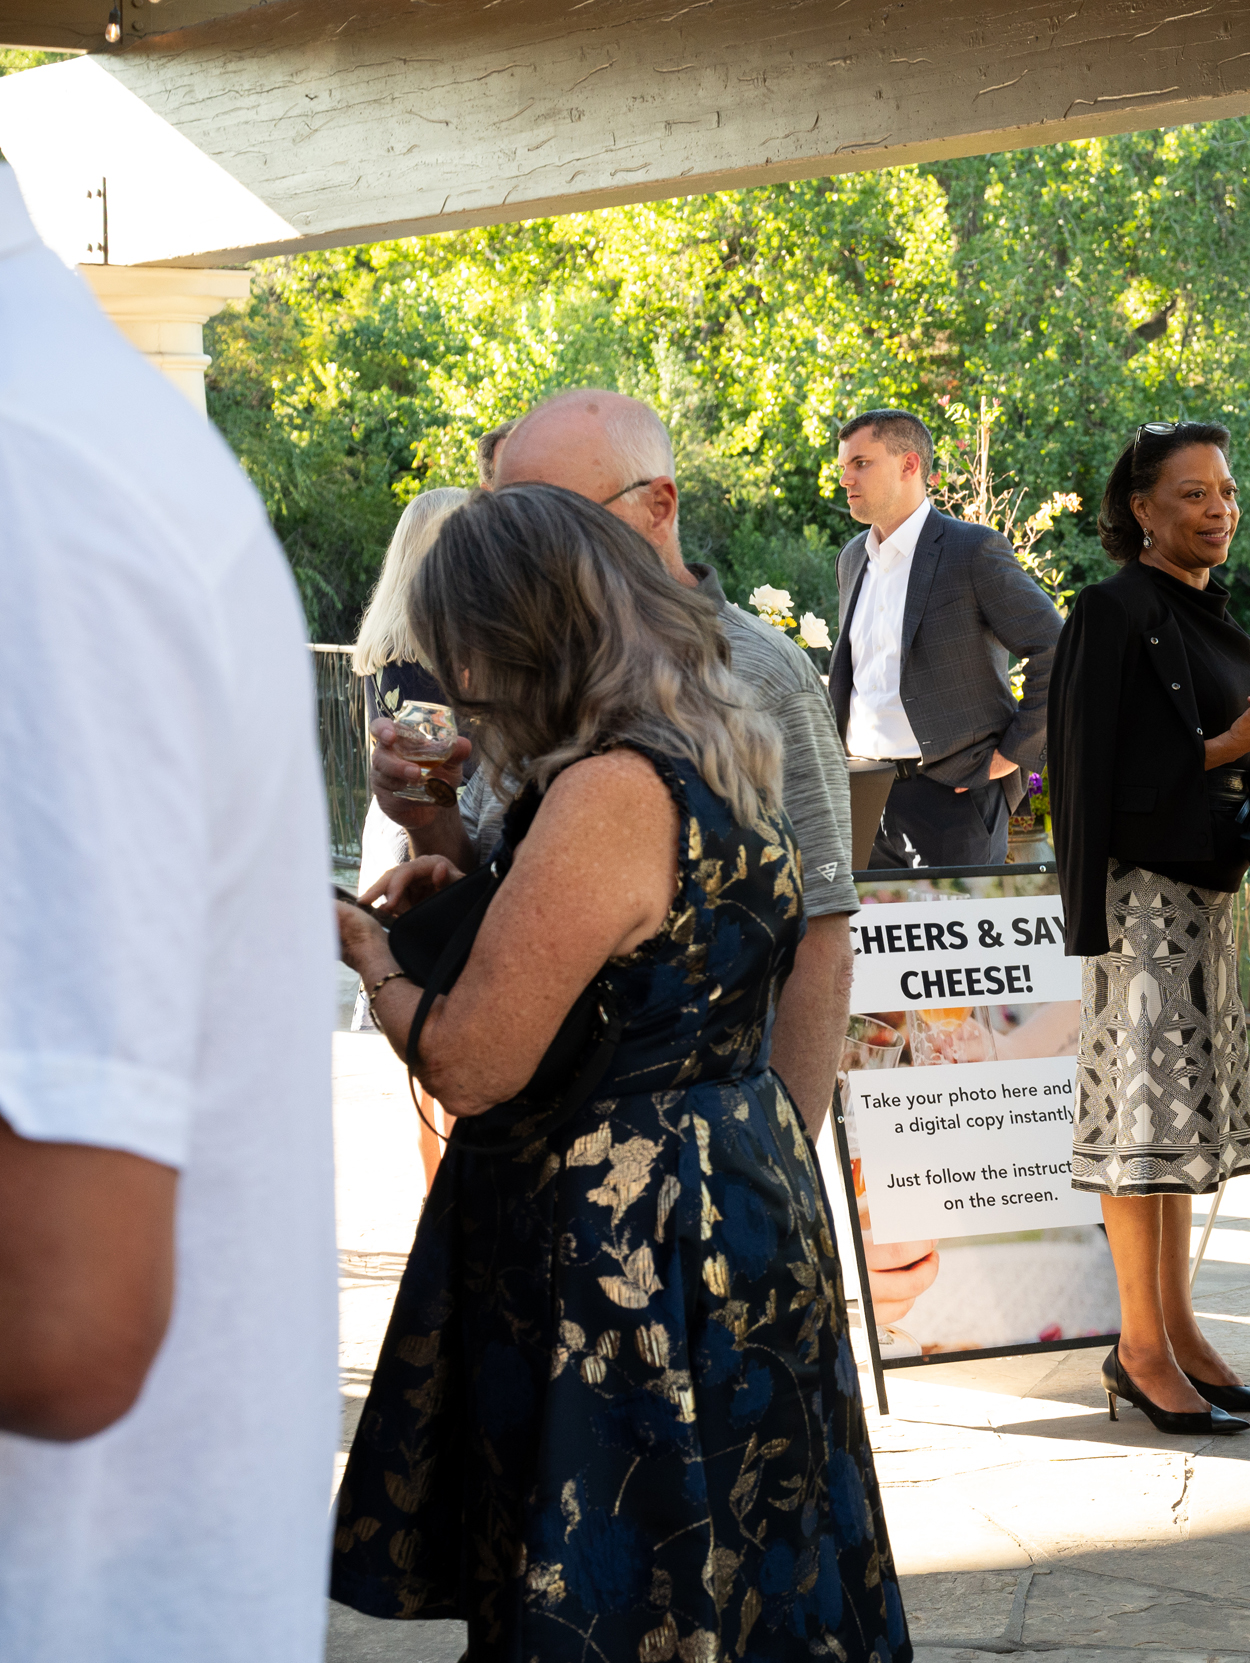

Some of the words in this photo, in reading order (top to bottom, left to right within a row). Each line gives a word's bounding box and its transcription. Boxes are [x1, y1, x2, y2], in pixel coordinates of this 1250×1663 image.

[977, 919, 1005, 948] &
[1011, 916, 1066, 947] SAY
[900, 964, 1034, 1000] CHEESE!
[860, 1092, 901, 1109] Take
[906, 1093, 943, 1110] your
[948, 1086, 997, 1106] photo
[1001, 1083, 1038, 1099] here
[1043, 1079, 1072, 1096] and
[894, 1122, 904, 1134] a
[909, 1113, 961, 1135] digital
[966, 1115, 1005, 1130] copy
[1009, 1105, 1074, 1125] instantly
[887, 1173, 921, 1189] Just
[925, 1167, 976, 1185] follow
[980, 1164, 1008, 1181] the
[943, 1198, 965, 1211] on
[968, 1192, 996, 1208] the
[1001, 1190, 1059, 1206] screen.
